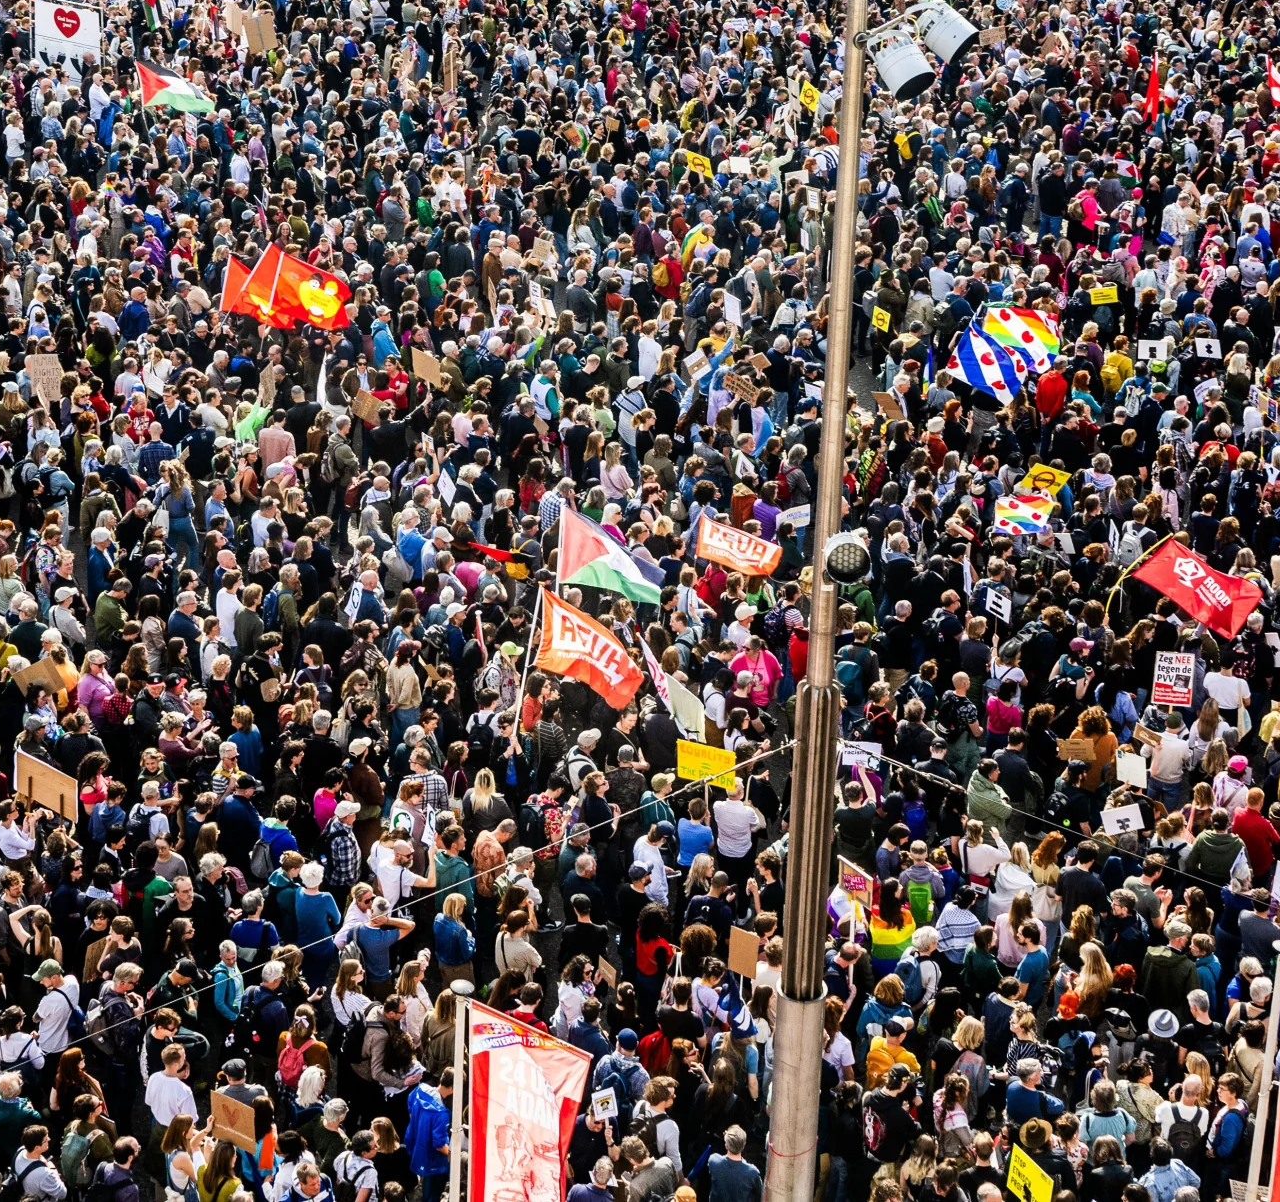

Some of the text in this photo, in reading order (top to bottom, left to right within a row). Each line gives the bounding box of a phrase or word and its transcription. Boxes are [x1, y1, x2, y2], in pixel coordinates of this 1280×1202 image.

[34, 368, 59, 377] RIGHTS
[1205, 575, 1231, 606] ROOD
[1158, 655, 1191, 667] Zeg NEE
[1158, 664, 1192, 675] tegen de
[1156, 674, 1173, 684] PVV
[499, 1054, 526, 1085] 24
[1013, 1155, 1029, 1168] STOP
